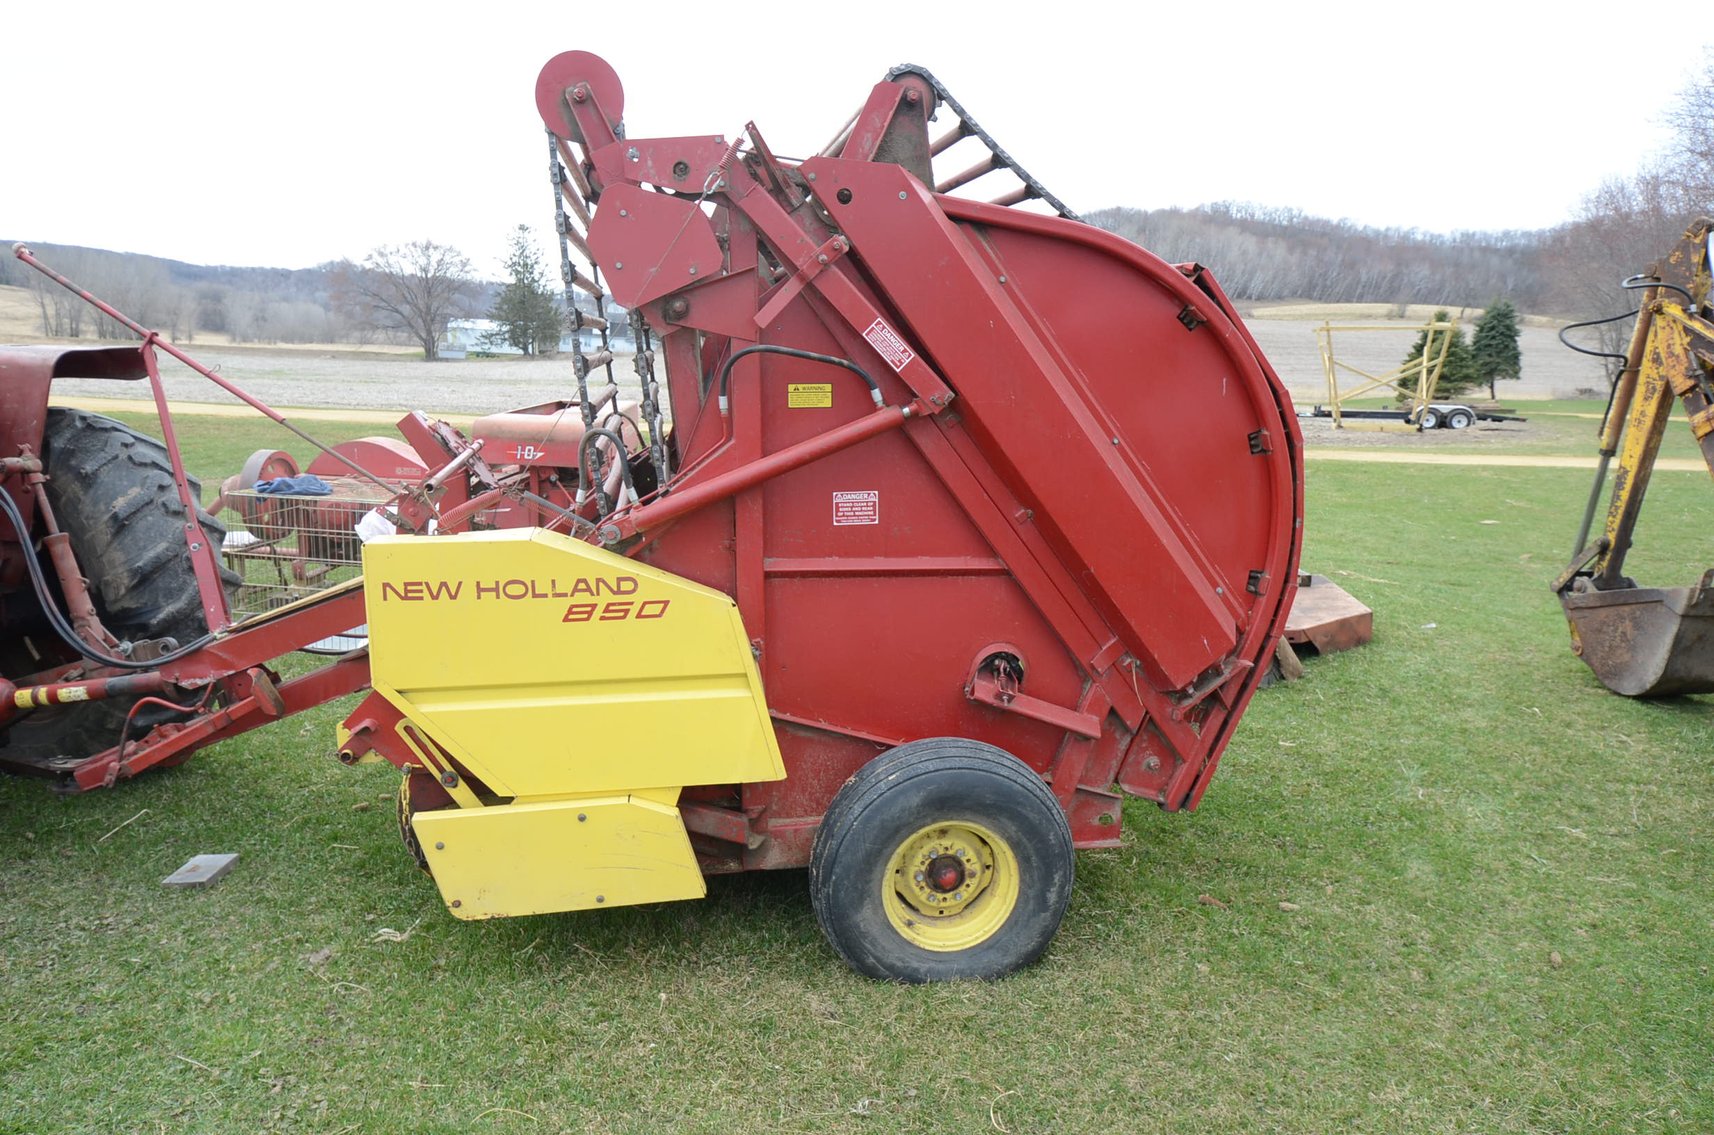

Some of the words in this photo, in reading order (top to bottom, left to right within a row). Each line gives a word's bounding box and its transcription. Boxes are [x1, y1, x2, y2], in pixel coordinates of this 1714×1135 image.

[882, 328, 905, 353] DANGER
[382, 581, 463, 601] NEW
[475, 576, 639, 600] HOLLAND
[562, 600, 671, 623] 850
